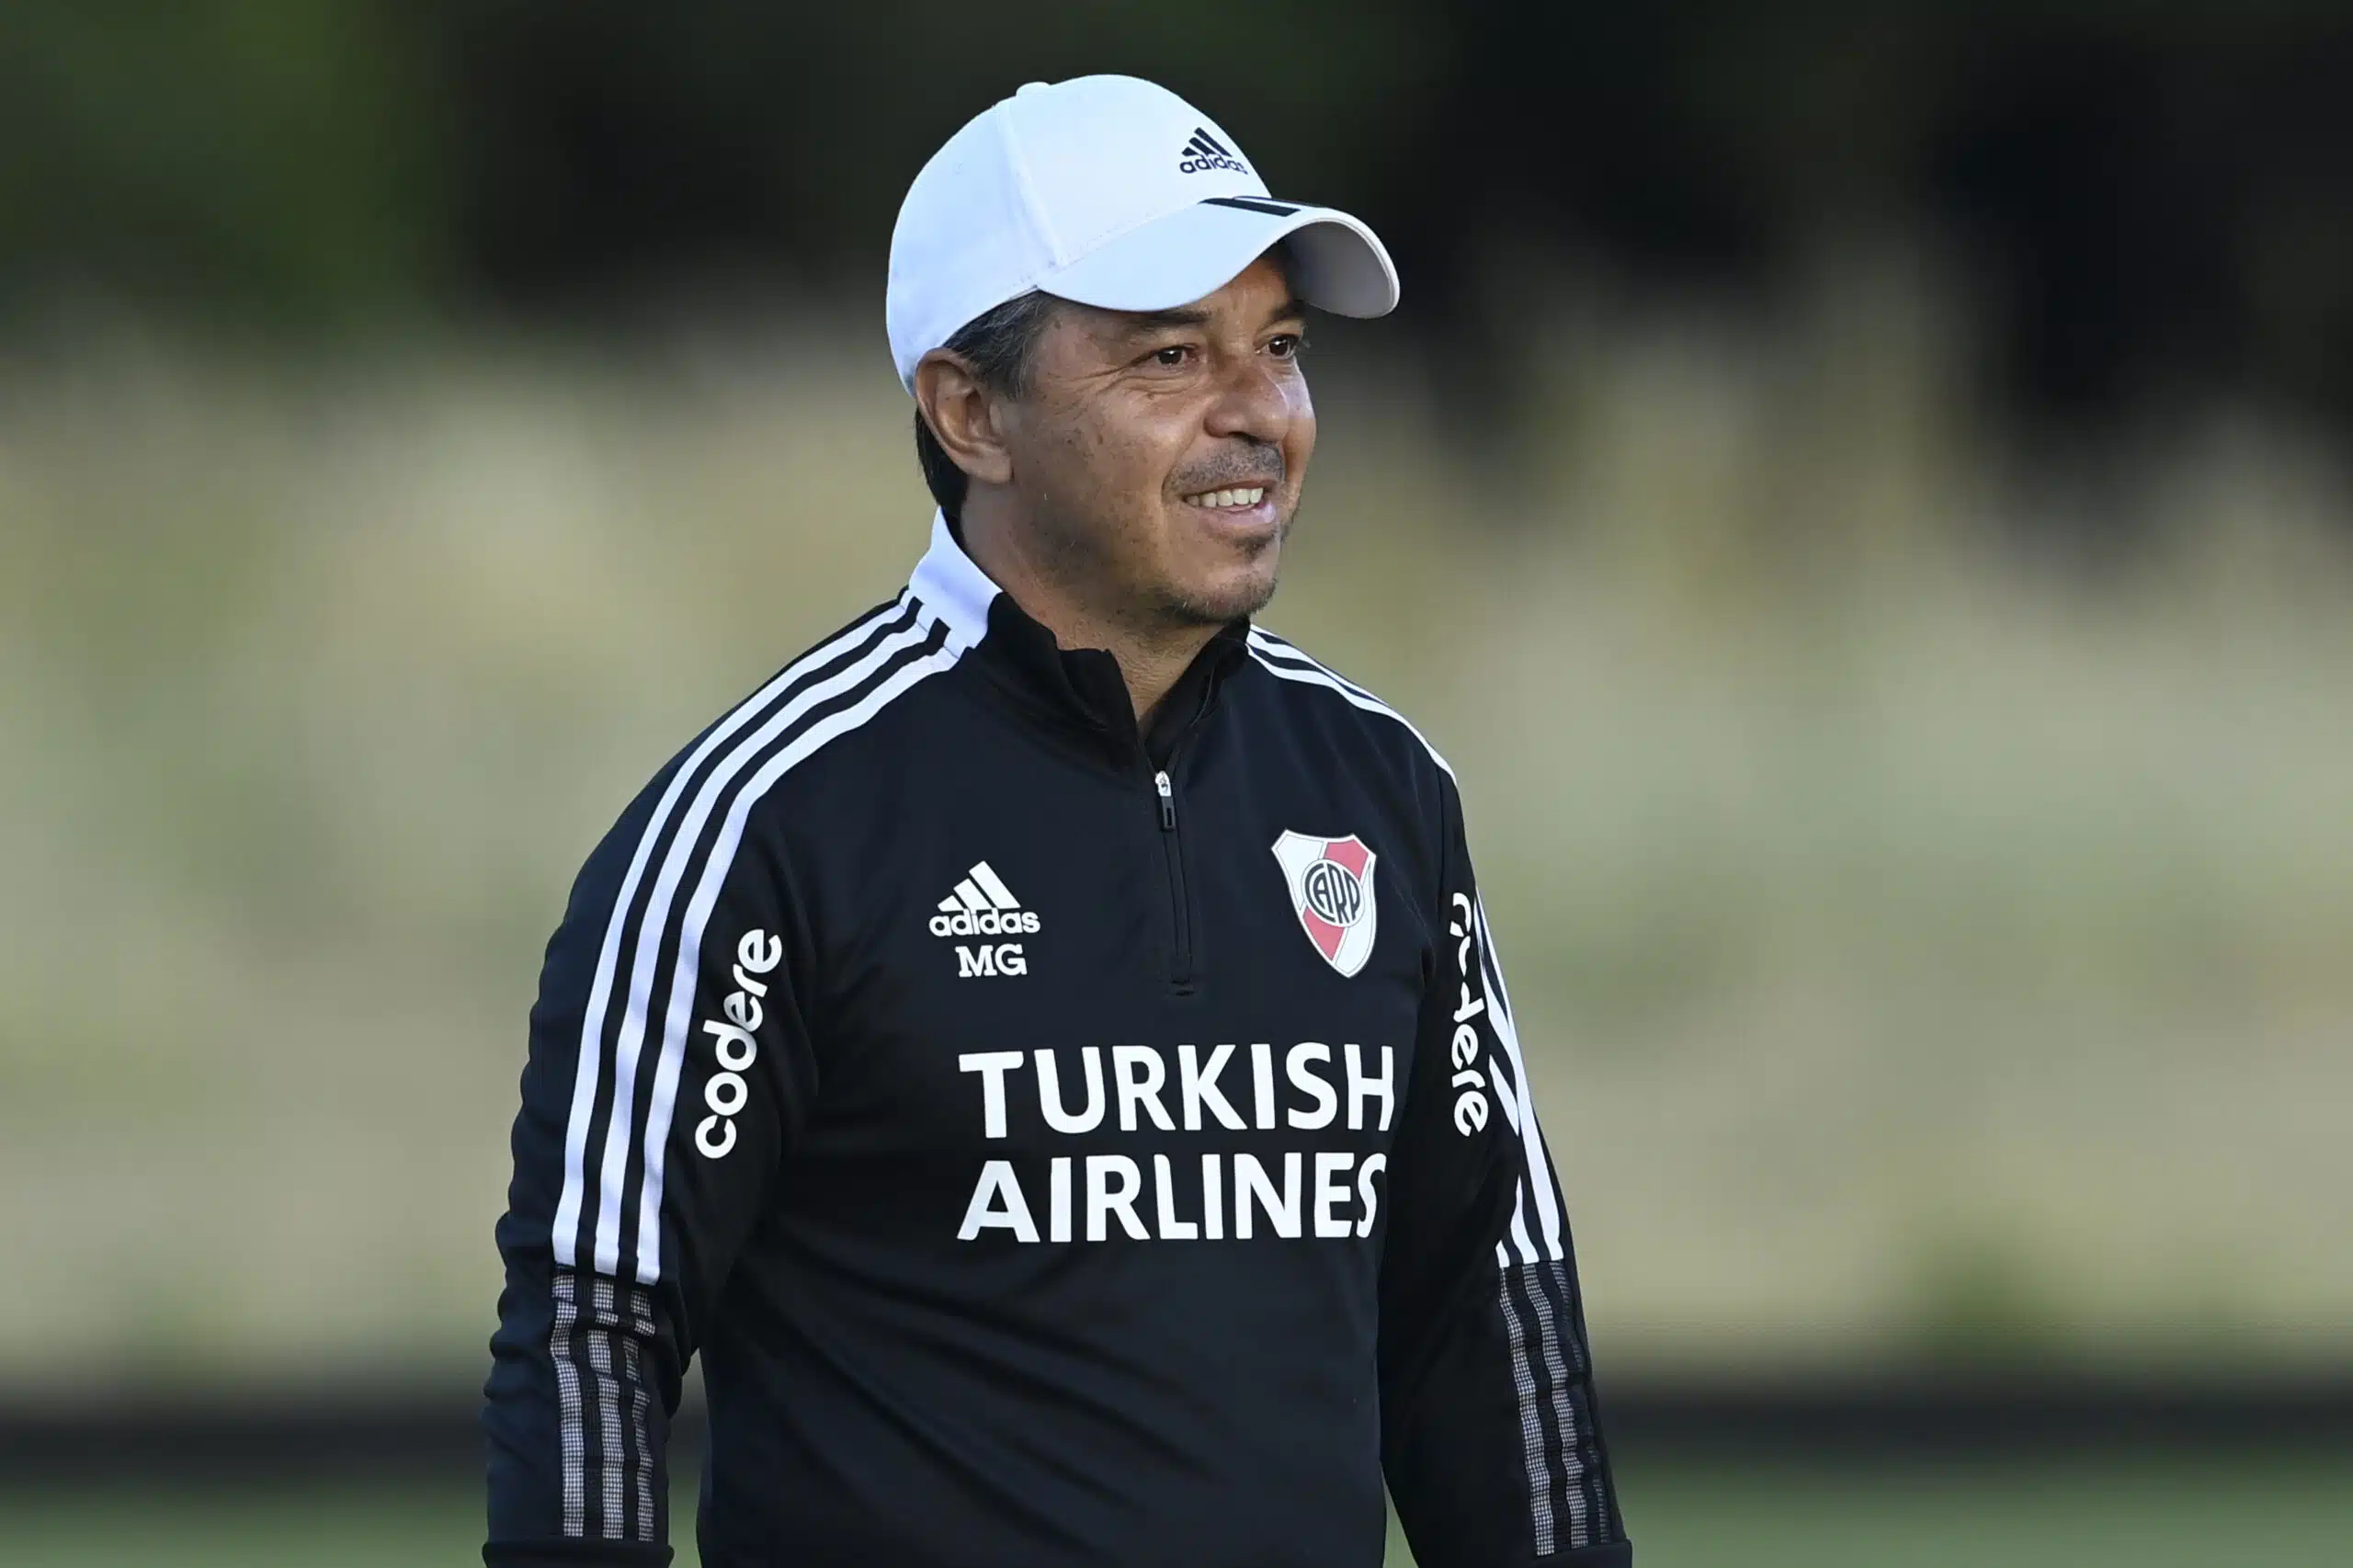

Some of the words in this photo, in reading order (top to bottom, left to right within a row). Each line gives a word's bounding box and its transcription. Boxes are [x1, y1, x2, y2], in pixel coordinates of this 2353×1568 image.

[1179, 154, 1248, 175] adidas
[928, 907, 1041, 937] adidas
[954, 943, 1028, 978] MG
[695, 928, 782, 1159] codere
[958, 1041, 1395, 1139] TURKISH
[956, 1152, 1387, 1244] AIRLINES
